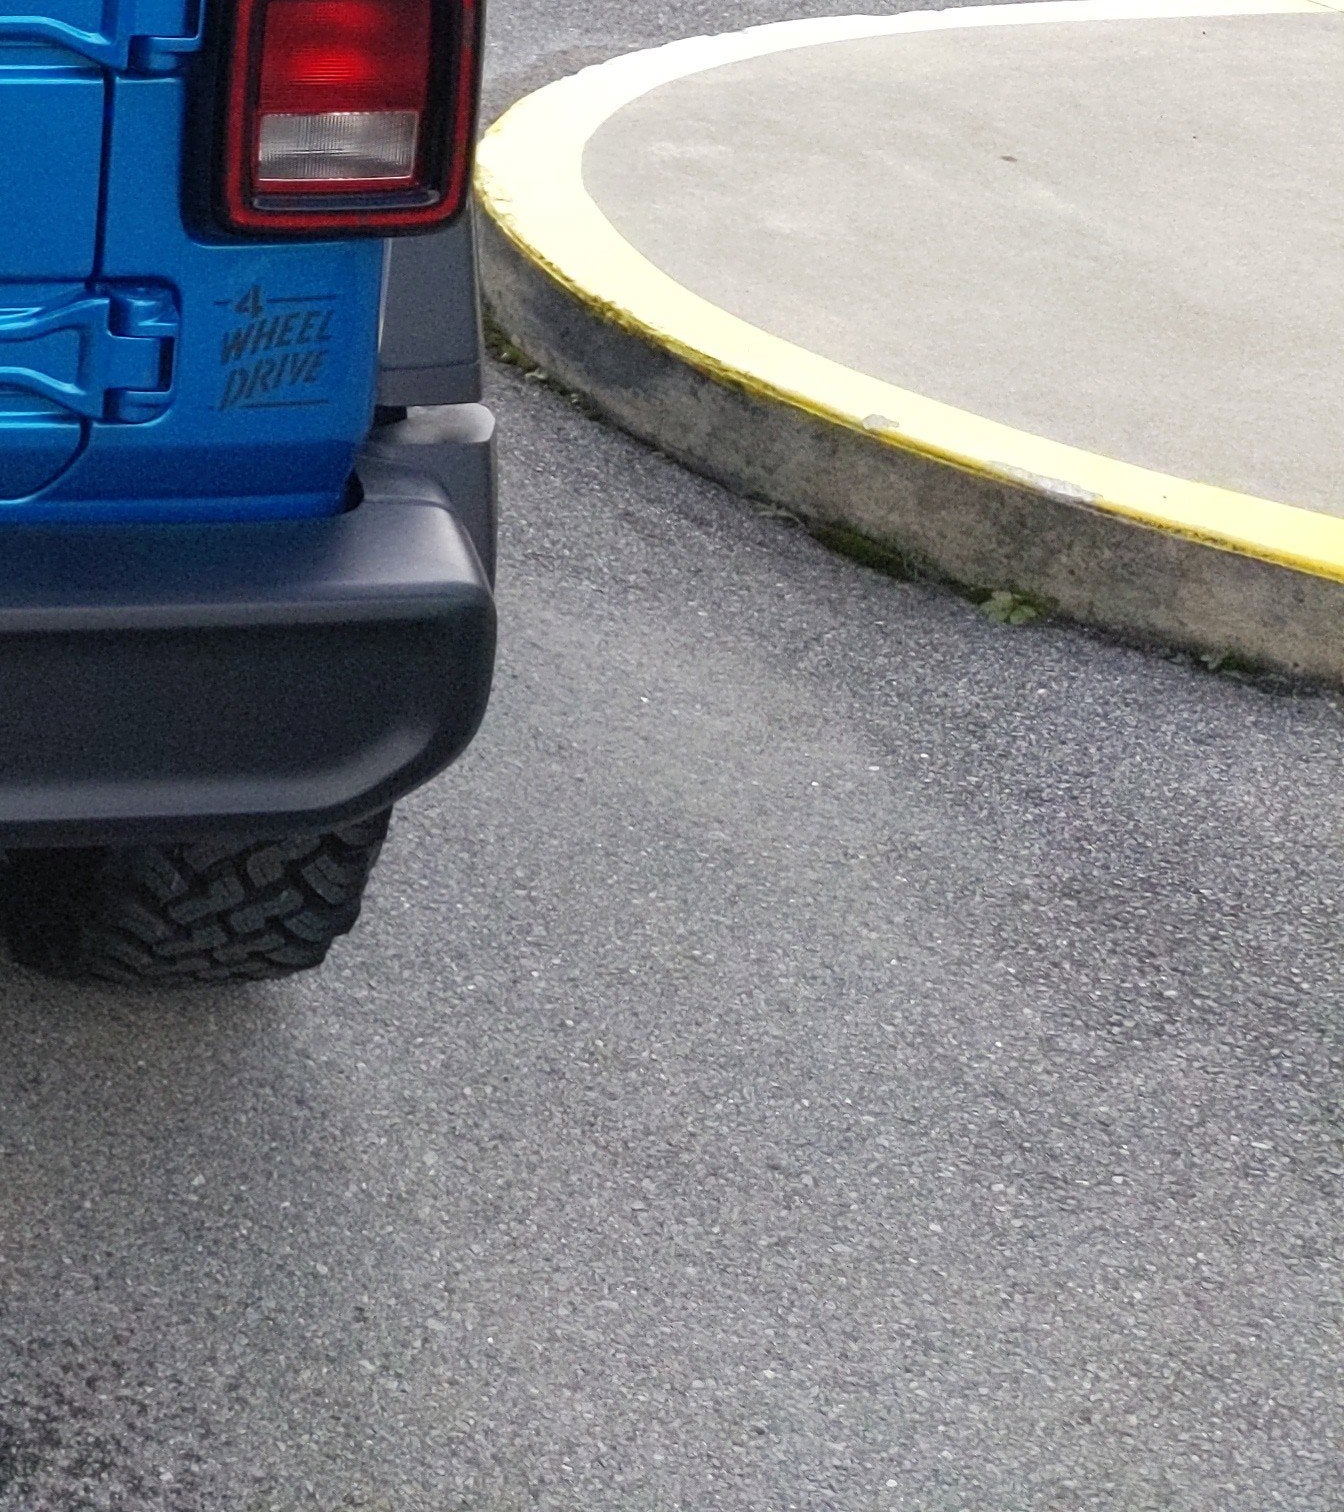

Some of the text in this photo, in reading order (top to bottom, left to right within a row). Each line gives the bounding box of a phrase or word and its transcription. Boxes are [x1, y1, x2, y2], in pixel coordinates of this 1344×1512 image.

[234, 284, 264, 319] 4
[221, 308, 334, 365] WHEEL
[218, 349, 328, 410] DRIVE
